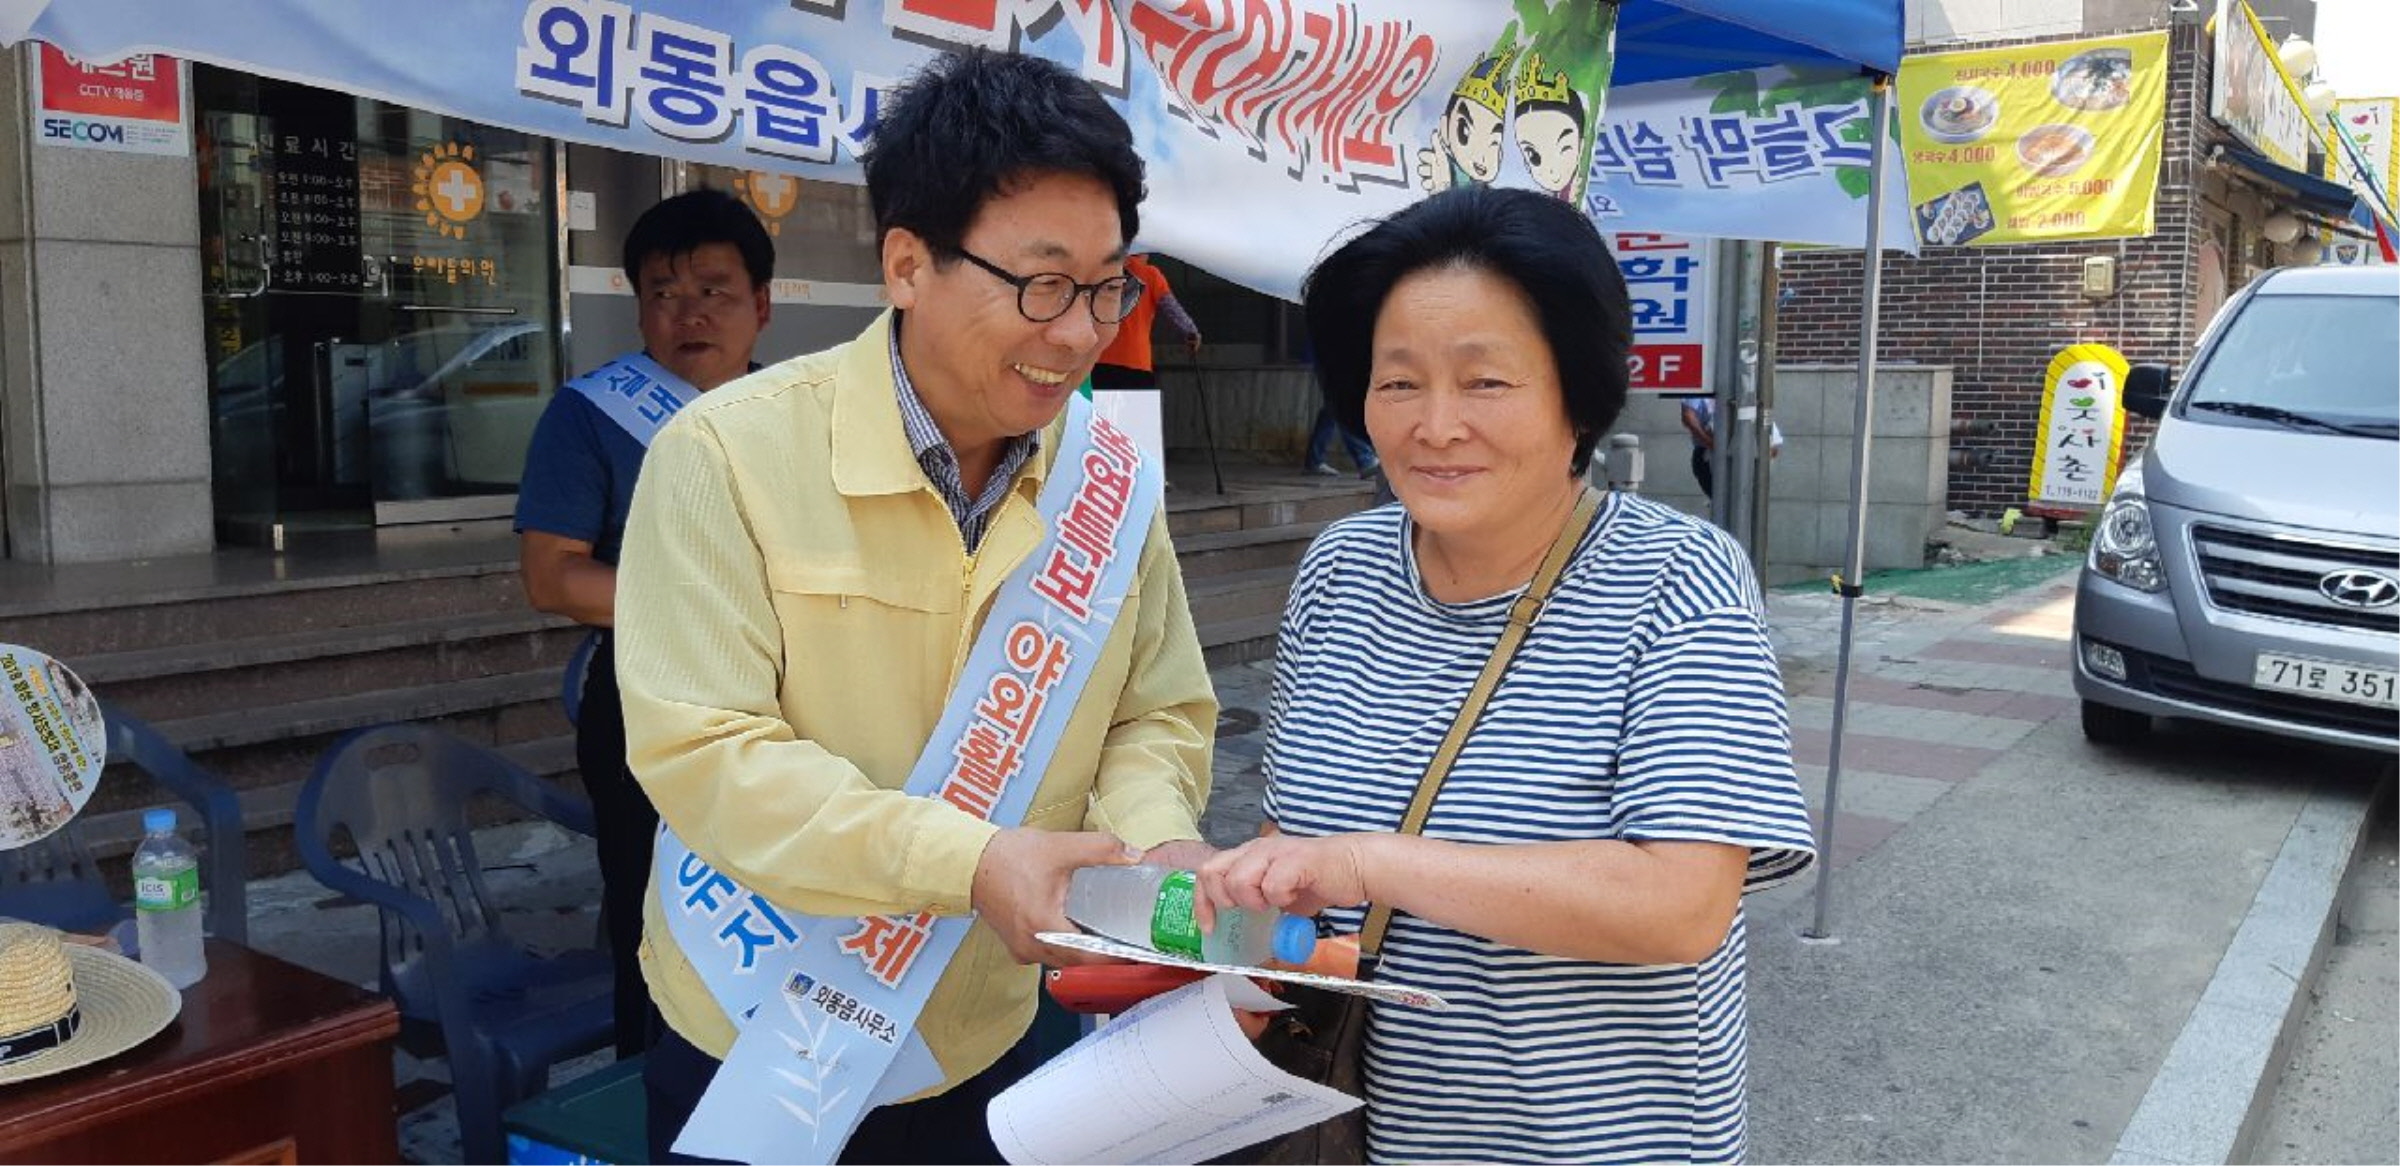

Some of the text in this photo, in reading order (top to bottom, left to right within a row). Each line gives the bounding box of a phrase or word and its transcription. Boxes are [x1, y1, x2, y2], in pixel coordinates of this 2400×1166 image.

[79, 84, 109, 98] CCTV
[44, 118, 124, 144] SECOM
[606, 364, 685, 425] 실내
[2271, 659, 2328, 690] 71로
[811, 984, 897, 1044] 외동읍사무소
